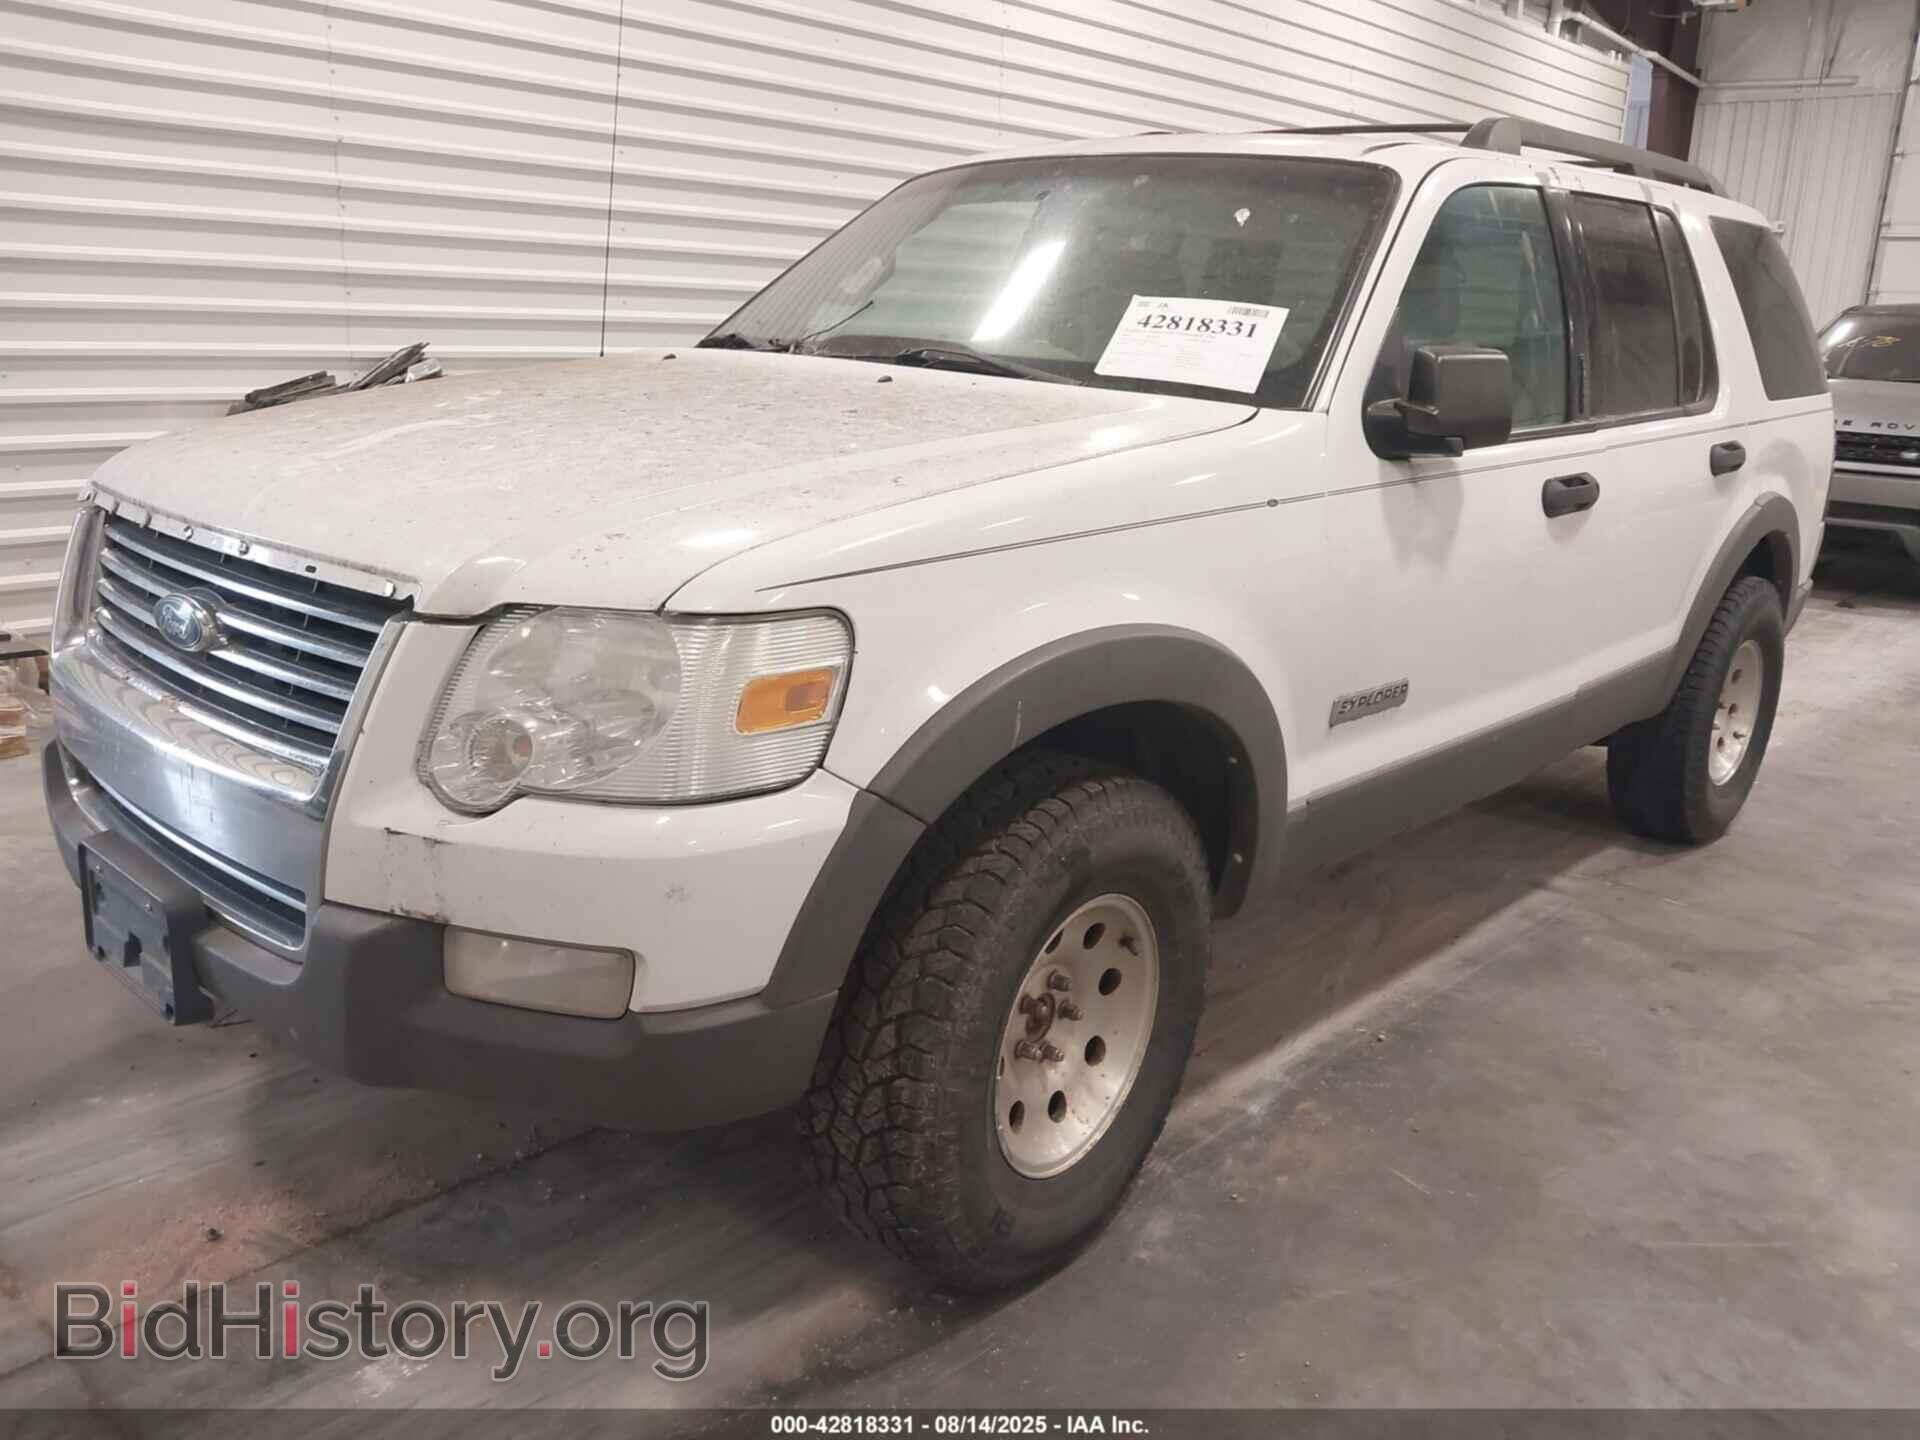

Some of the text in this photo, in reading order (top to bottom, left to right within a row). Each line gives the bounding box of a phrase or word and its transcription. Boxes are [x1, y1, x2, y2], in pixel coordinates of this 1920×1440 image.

[1136, 313, 1258, 339] 42818331
[162, 603, 192, 641] Ford
[1336, 682, 1409, 715] EXPLORER
